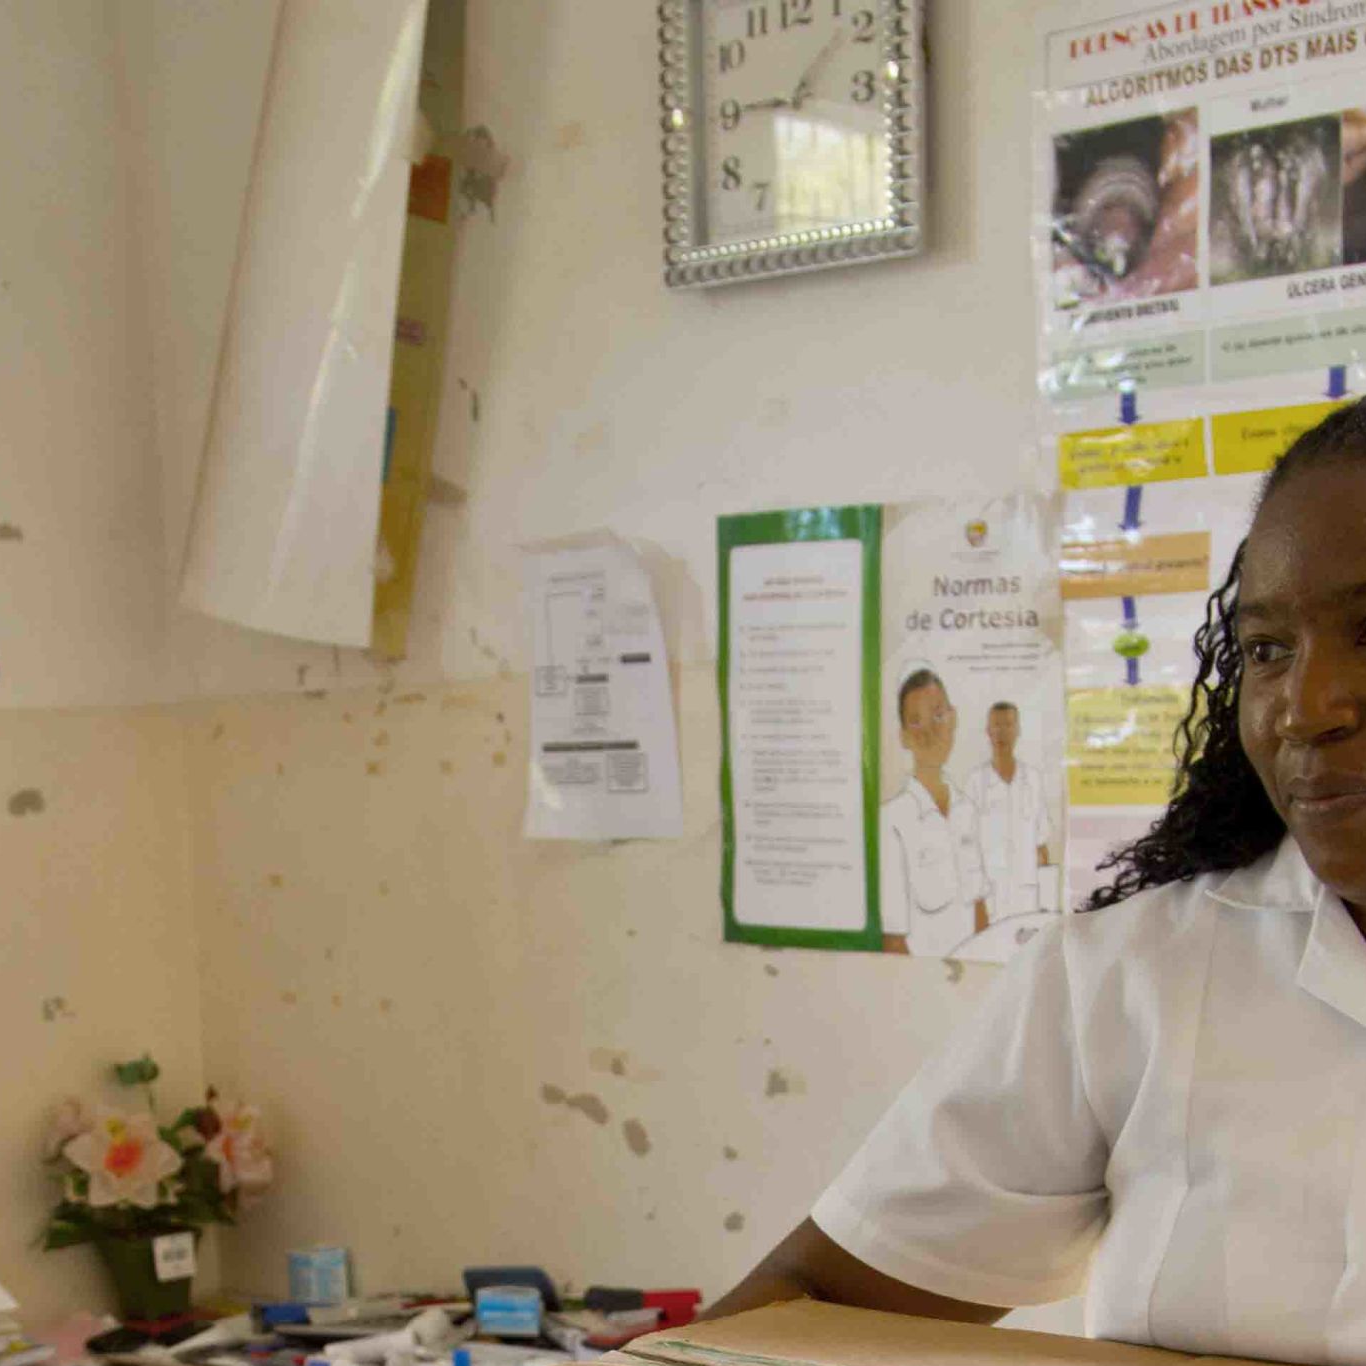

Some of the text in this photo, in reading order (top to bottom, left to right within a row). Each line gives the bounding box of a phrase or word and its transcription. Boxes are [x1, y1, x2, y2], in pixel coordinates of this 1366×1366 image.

[746, 6, 768, 39] 11
[851, 10, 875, 43] 2
[718, 40, 746, 73] 10
[1086, 61, 1208, 107] ALGORITMOS
[1215, 51, 1253, 79] DAS
[1258, 41, 1300, 71] DTS
[1305, 29, 1358, 60] MAIS
[851, 70, 876, 103] 3
[721, 99, 741, 131] 9
[722, 156, 742, 191] 8
[753, 182, 770, 211] 7
[932, 574, 1023, 598] Normas
[905, 606, 1040, 632] de Cortesia
